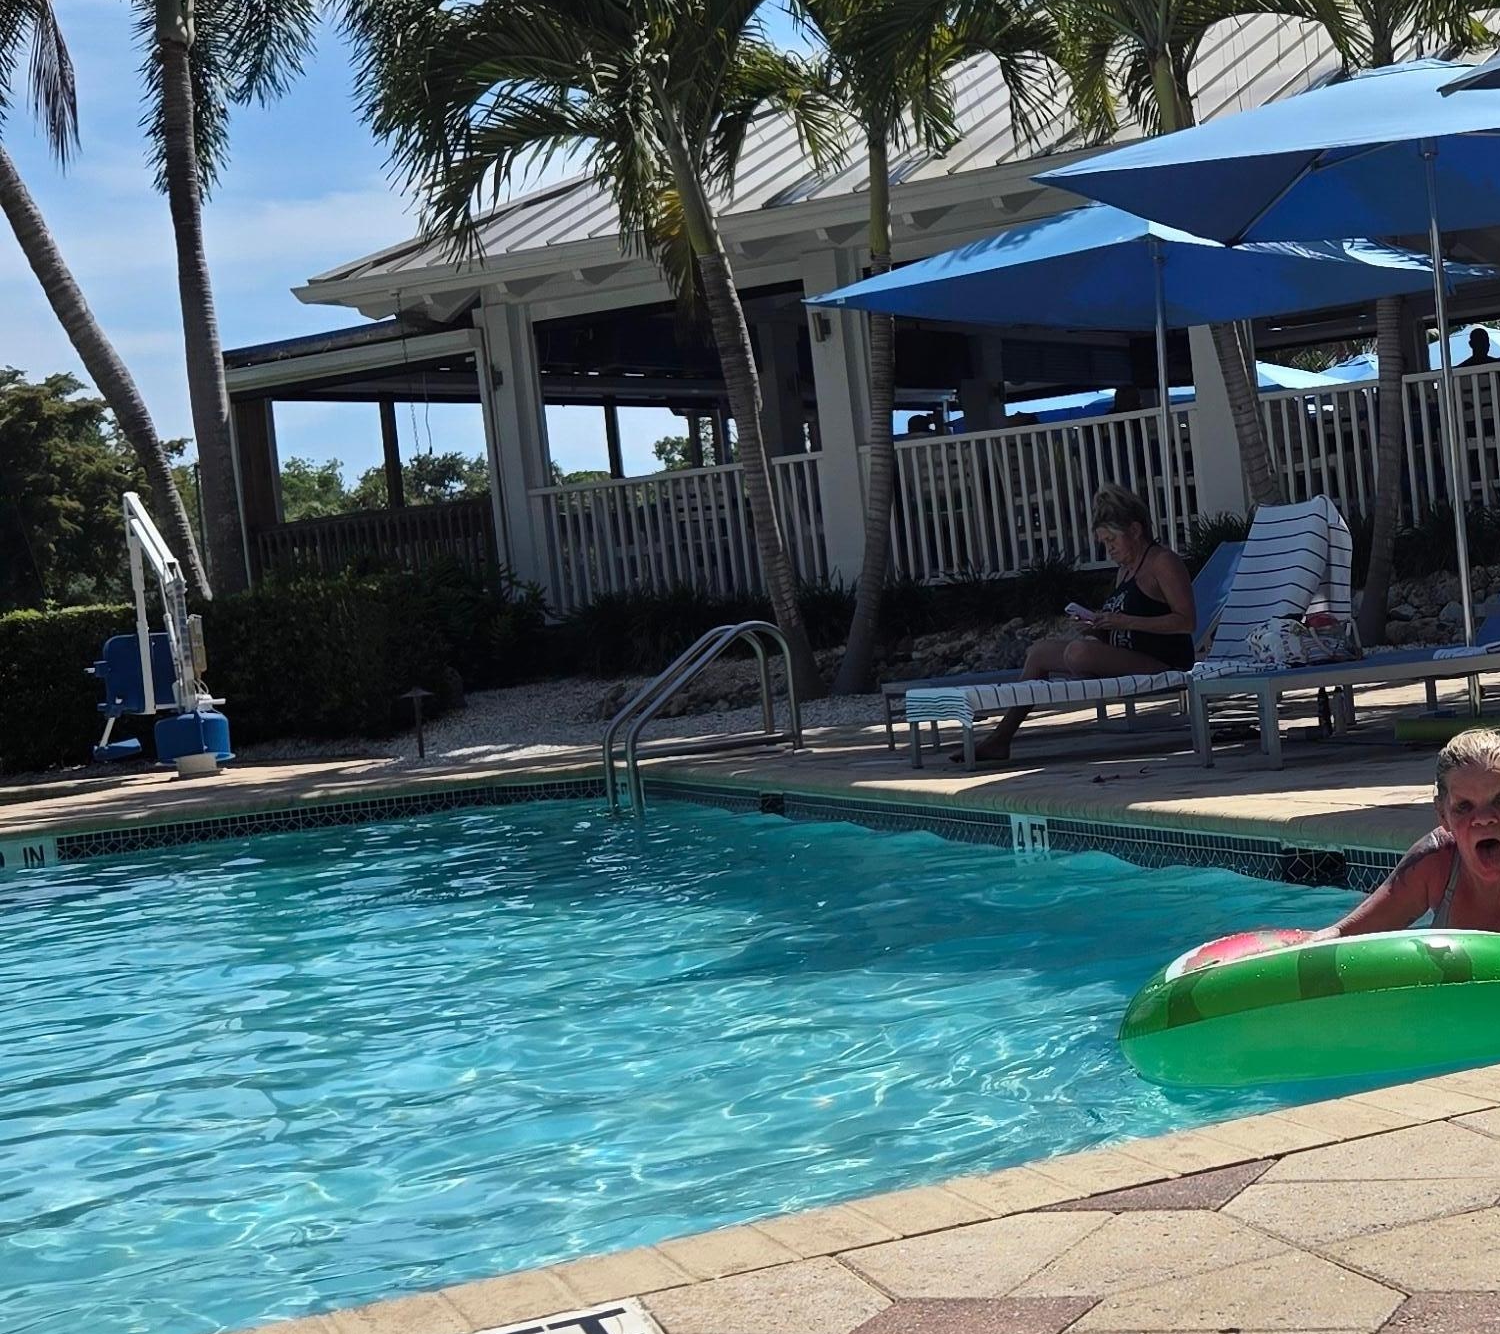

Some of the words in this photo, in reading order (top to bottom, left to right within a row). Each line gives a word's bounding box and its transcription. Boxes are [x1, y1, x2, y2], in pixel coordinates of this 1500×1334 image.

[1017, 821, 1027, 852] 4
[1029, 823, 1047, 852] FT
[22, 845, 46, 868] IN
